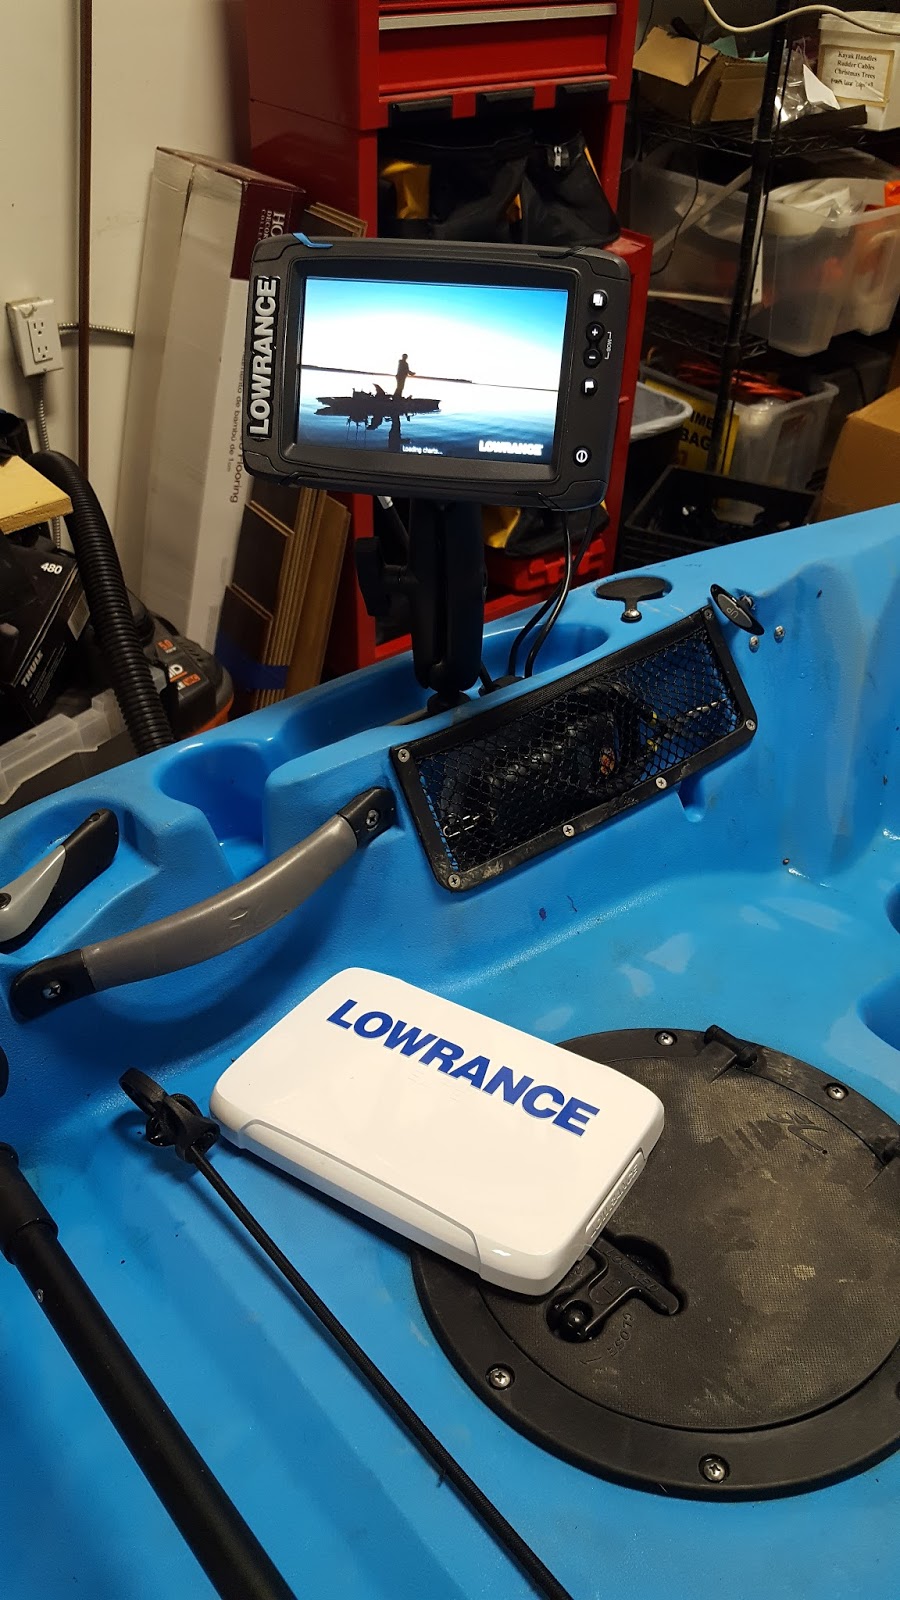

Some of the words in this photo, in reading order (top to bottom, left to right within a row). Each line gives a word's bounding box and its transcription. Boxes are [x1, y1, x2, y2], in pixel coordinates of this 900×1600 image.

[838, 51, 854, 60] Kayak
[834, 68, 860, 77] Christmas
[857, 62, 875, 70] Cables
[250, 278, 277, 436] LOWRANCE
[402, 445, 422, 455] Loading
[478, 440, 543, 456] LOWRANCE
[40, 562, 63, 575] 480
[727, 607, 739, 619] UP
[21, 649, 44, 688] THULE
[325, 998, 601, 1138] LOWRANCE
[606, 1312, 634, 1358] CLOSE
